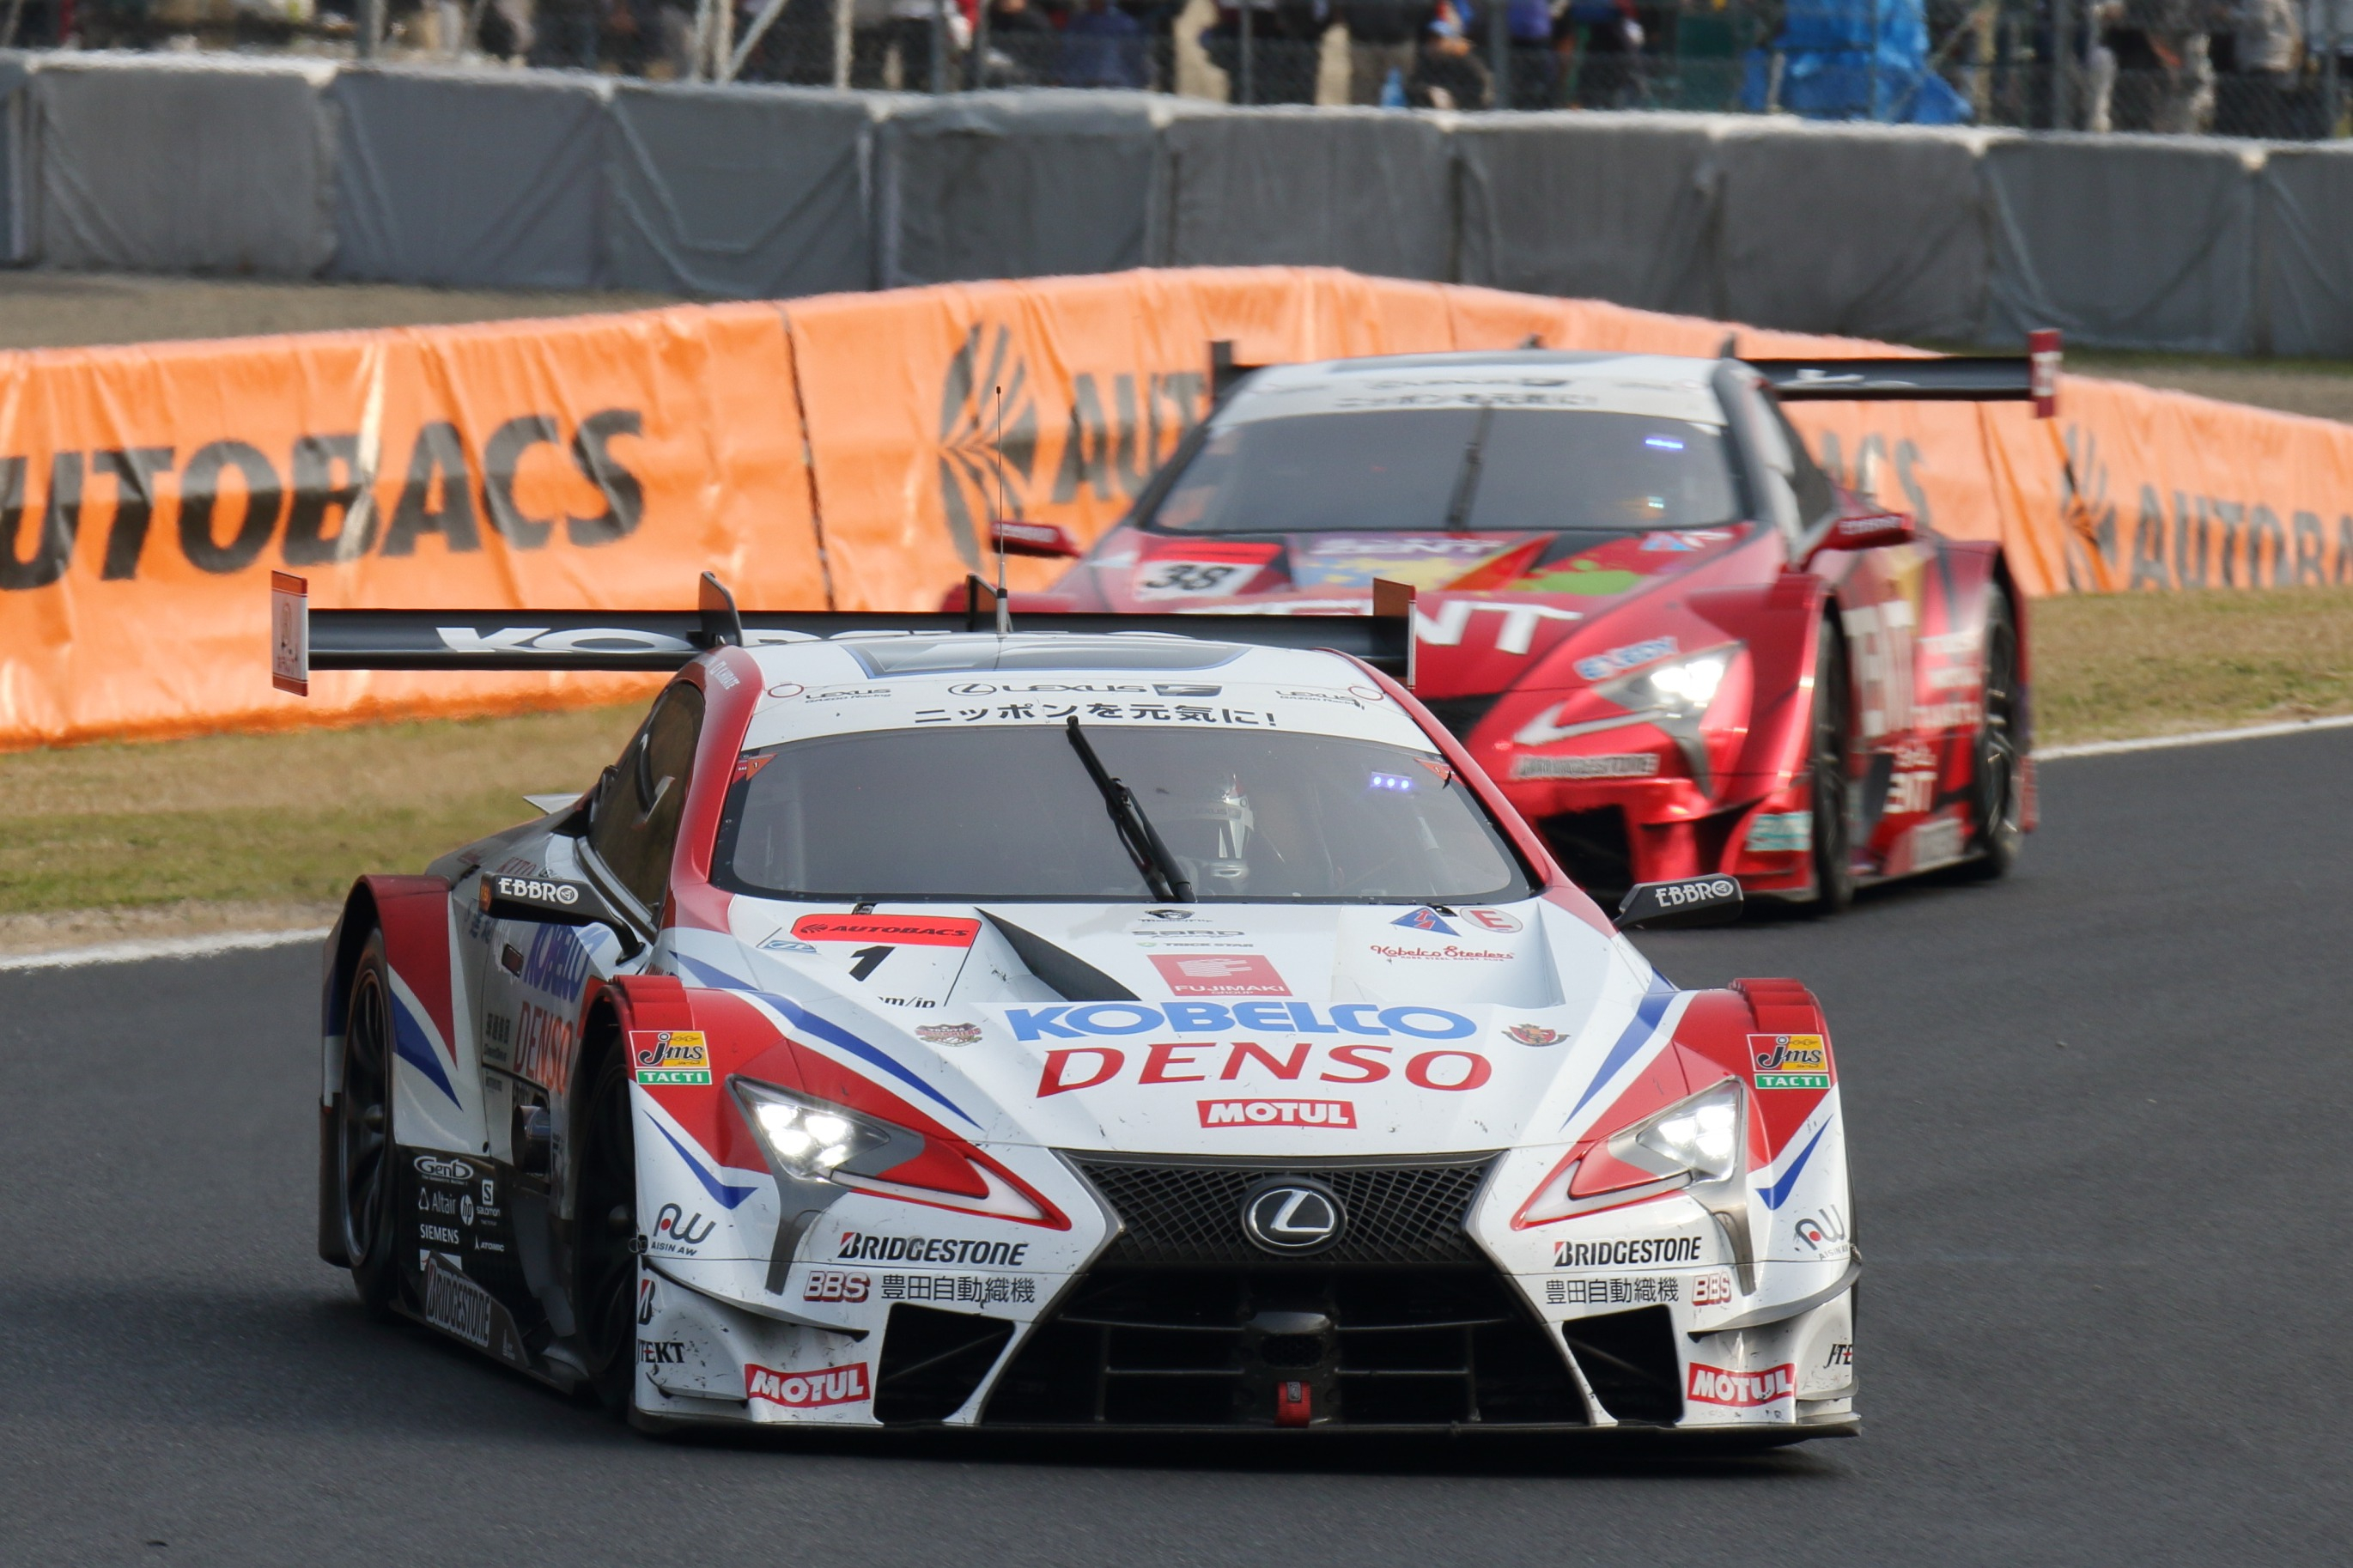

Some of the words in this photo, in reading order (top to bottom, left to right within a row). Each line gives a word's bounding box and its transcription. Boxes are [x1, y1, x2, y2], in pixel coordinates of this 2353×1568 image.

[1144, 563, 1235, 591] 38
[806, 689, 891, 699] LEXUS
[1001, 684, 1147, 694] LEXUS
[915, 702, 1277, 726] ニッポンを元気に!
[498, 878, 579, 904] EBBRO
[1655, 880, 1734, 907] EBBRO
[830, 924, 970, 937] AUTOBACS
[848, 945, 897, 982] 1
[1371, 945, 1441, 958] Kobelco
[1443, 945, 1515, 959] Steelers
[1005, 1001, 1476, 1041] KOBELCO
[513, 1001, 575, 1096] DENSO
[639, 1032, 704, 1064] jms
[1757, 1036, 1822, 1069] jms
[644, 1072, 704, 1084] TACTI
[1037, 1042, 1493, 1098] DENSO
[1762, 1076, 1821, 1086] TACTI
[1207, 1103, 1350, 1125] MOTUL
[432, 1189, 456, 1216] Altair
[420, 1224, 460, 1245] SIEMENS
[651, 1242, 675, 1253] AISIN
[677, 1246, 698, 1256] AW
[838, 1231, 1030, 1267] BRIDGESTONE
[1554, 1237, 1702, 1267] BRIDGESTONE
[804, 1272, 871, 1303] BBS
[881, 1274, 1036, 1304] 豊田自動織機
[1546, 1277, 1680, 1304] 豊田自動織機
[1691, 1273, 1732, 1306] BBS
[428, 1261, 489, 1344] BRIDGESTONE
[750, 1368, 864, 1403] MOTUL
[1692, 1368, 1793, 1402] MOTUL
